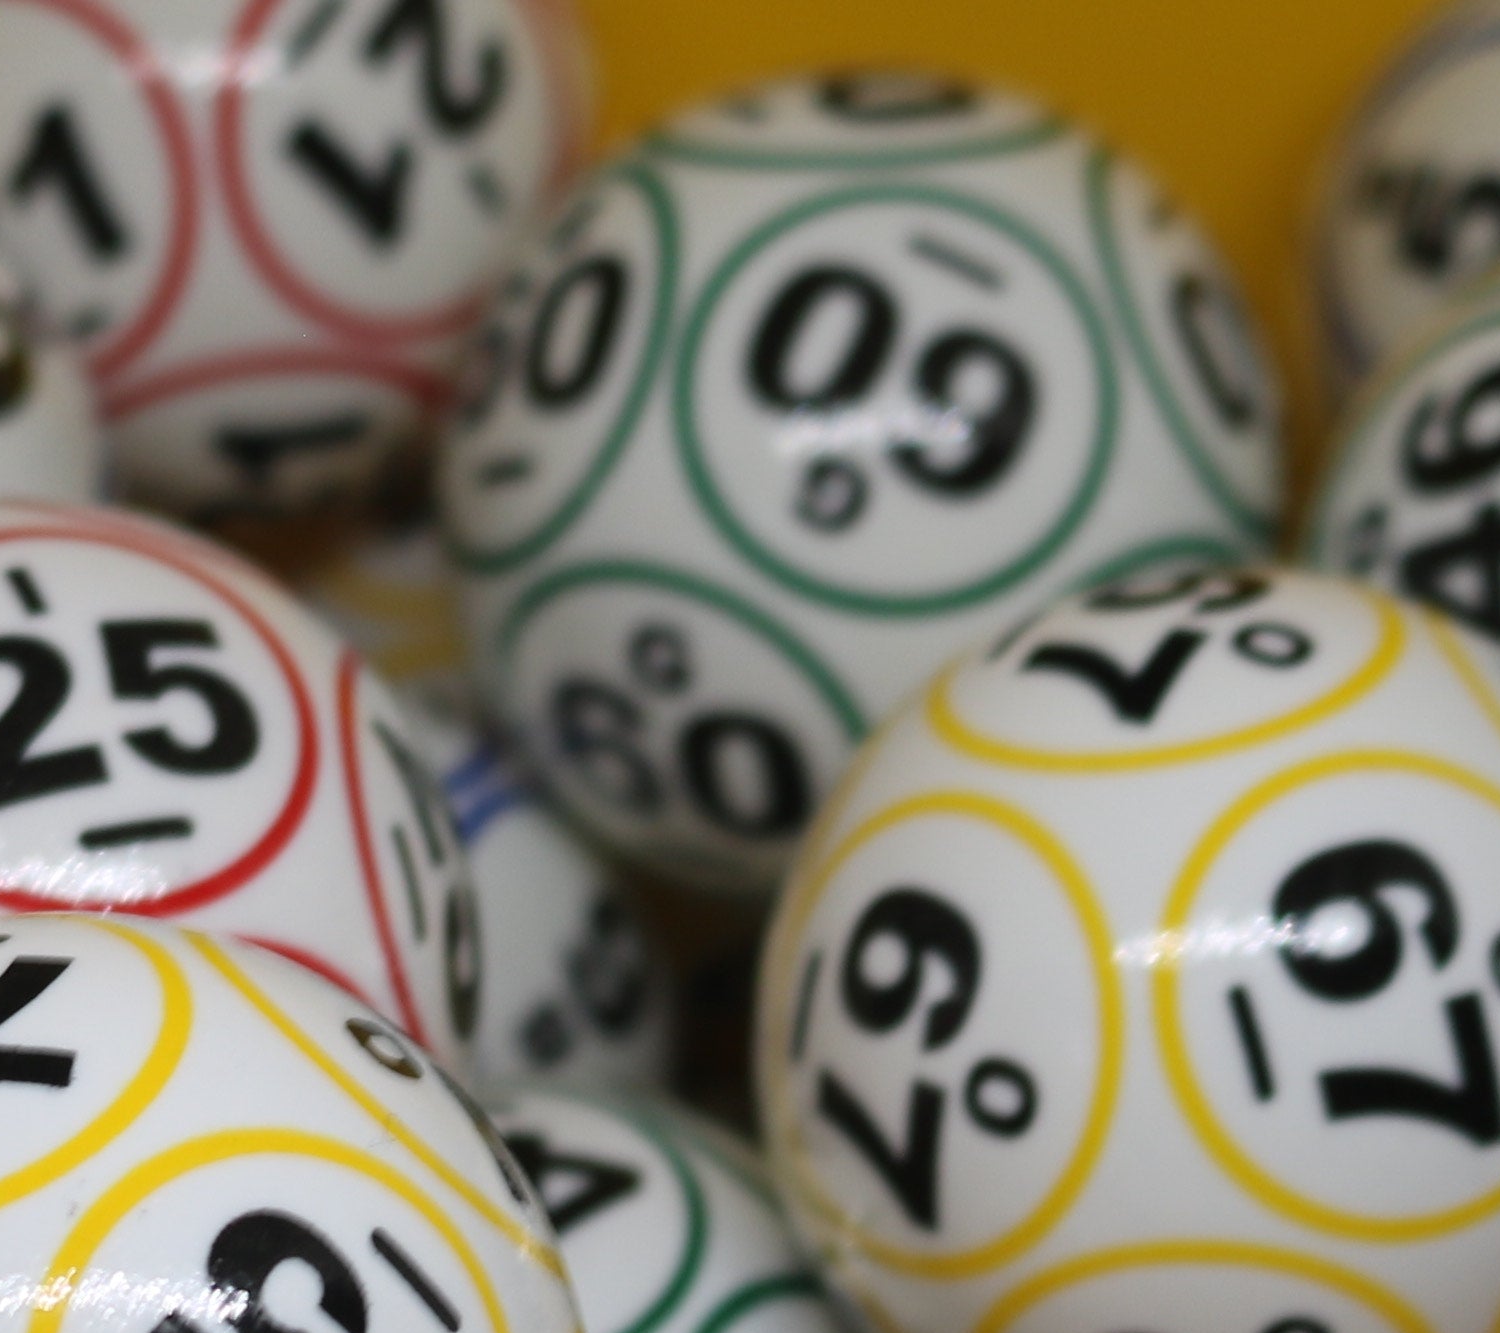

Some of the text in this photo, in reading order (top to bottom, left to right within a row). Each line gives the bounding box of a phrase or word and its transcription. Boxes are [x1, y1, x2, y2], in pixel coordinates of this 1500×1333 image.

[744, 264, 1042, 502] 60
[814, 885, 983, 1235] 67
[962, 1057, 1040, 1142] O
